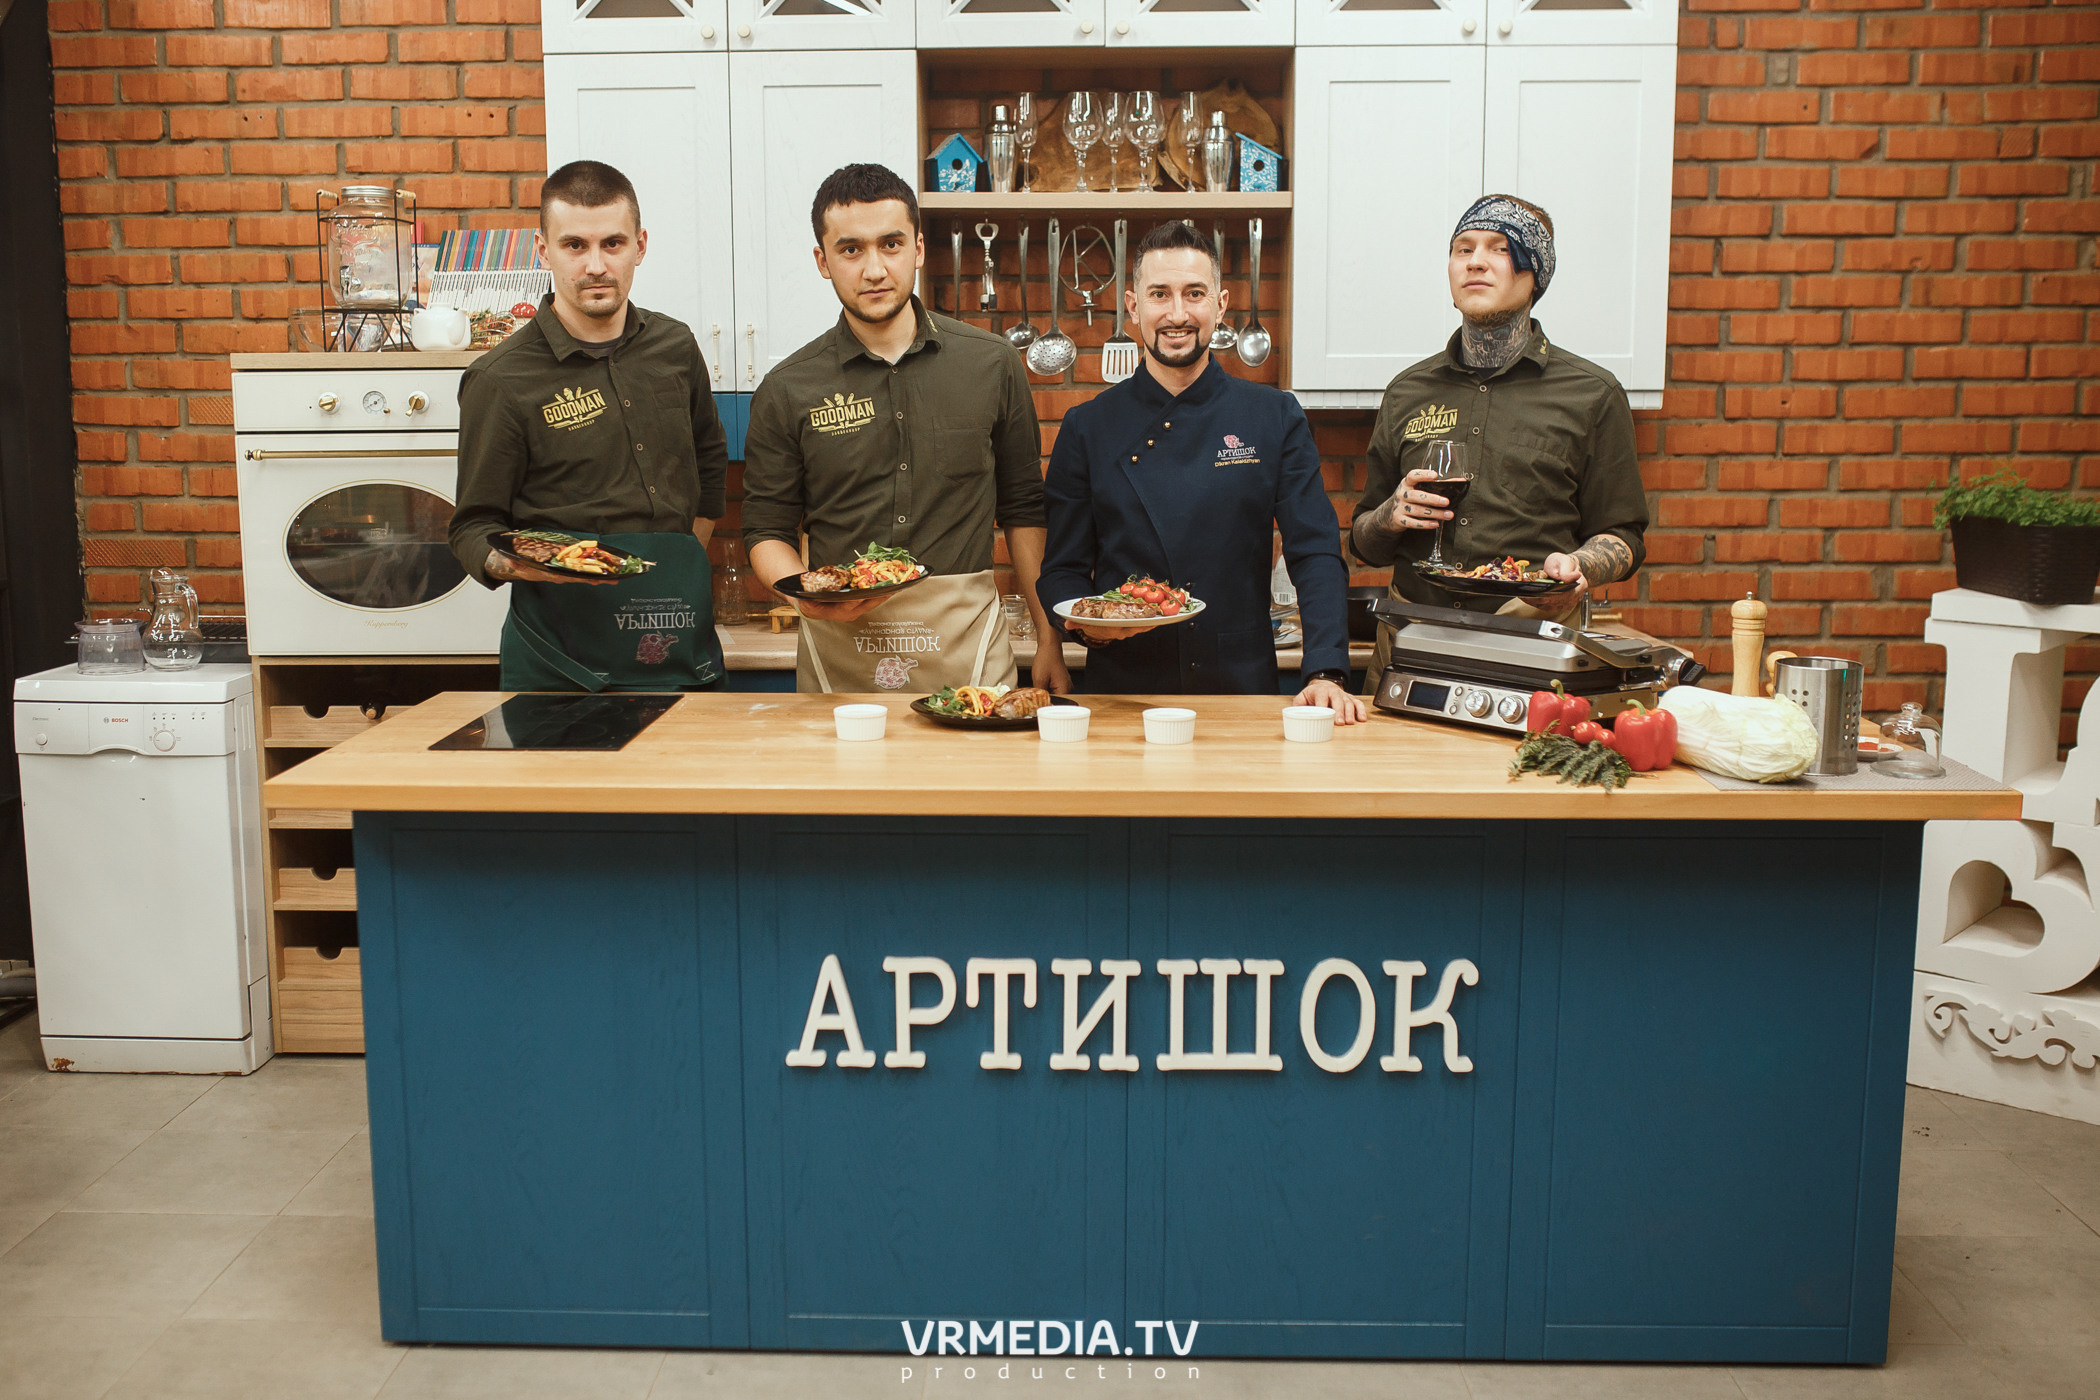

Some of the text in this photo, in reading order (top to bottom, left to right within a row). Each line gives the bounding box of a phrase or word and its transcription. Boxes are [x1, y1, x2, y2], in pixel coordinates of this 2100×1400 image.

[543, 392, 606, 424] GOODMAN
[810, 401, 875, 427] GOODMAN
[1405, 412, 1458, 435] GOODMAN
[1217, 446, 1256, 458] АРТИШОК
[786, 953, 1479, 1074] АРТИШОК
